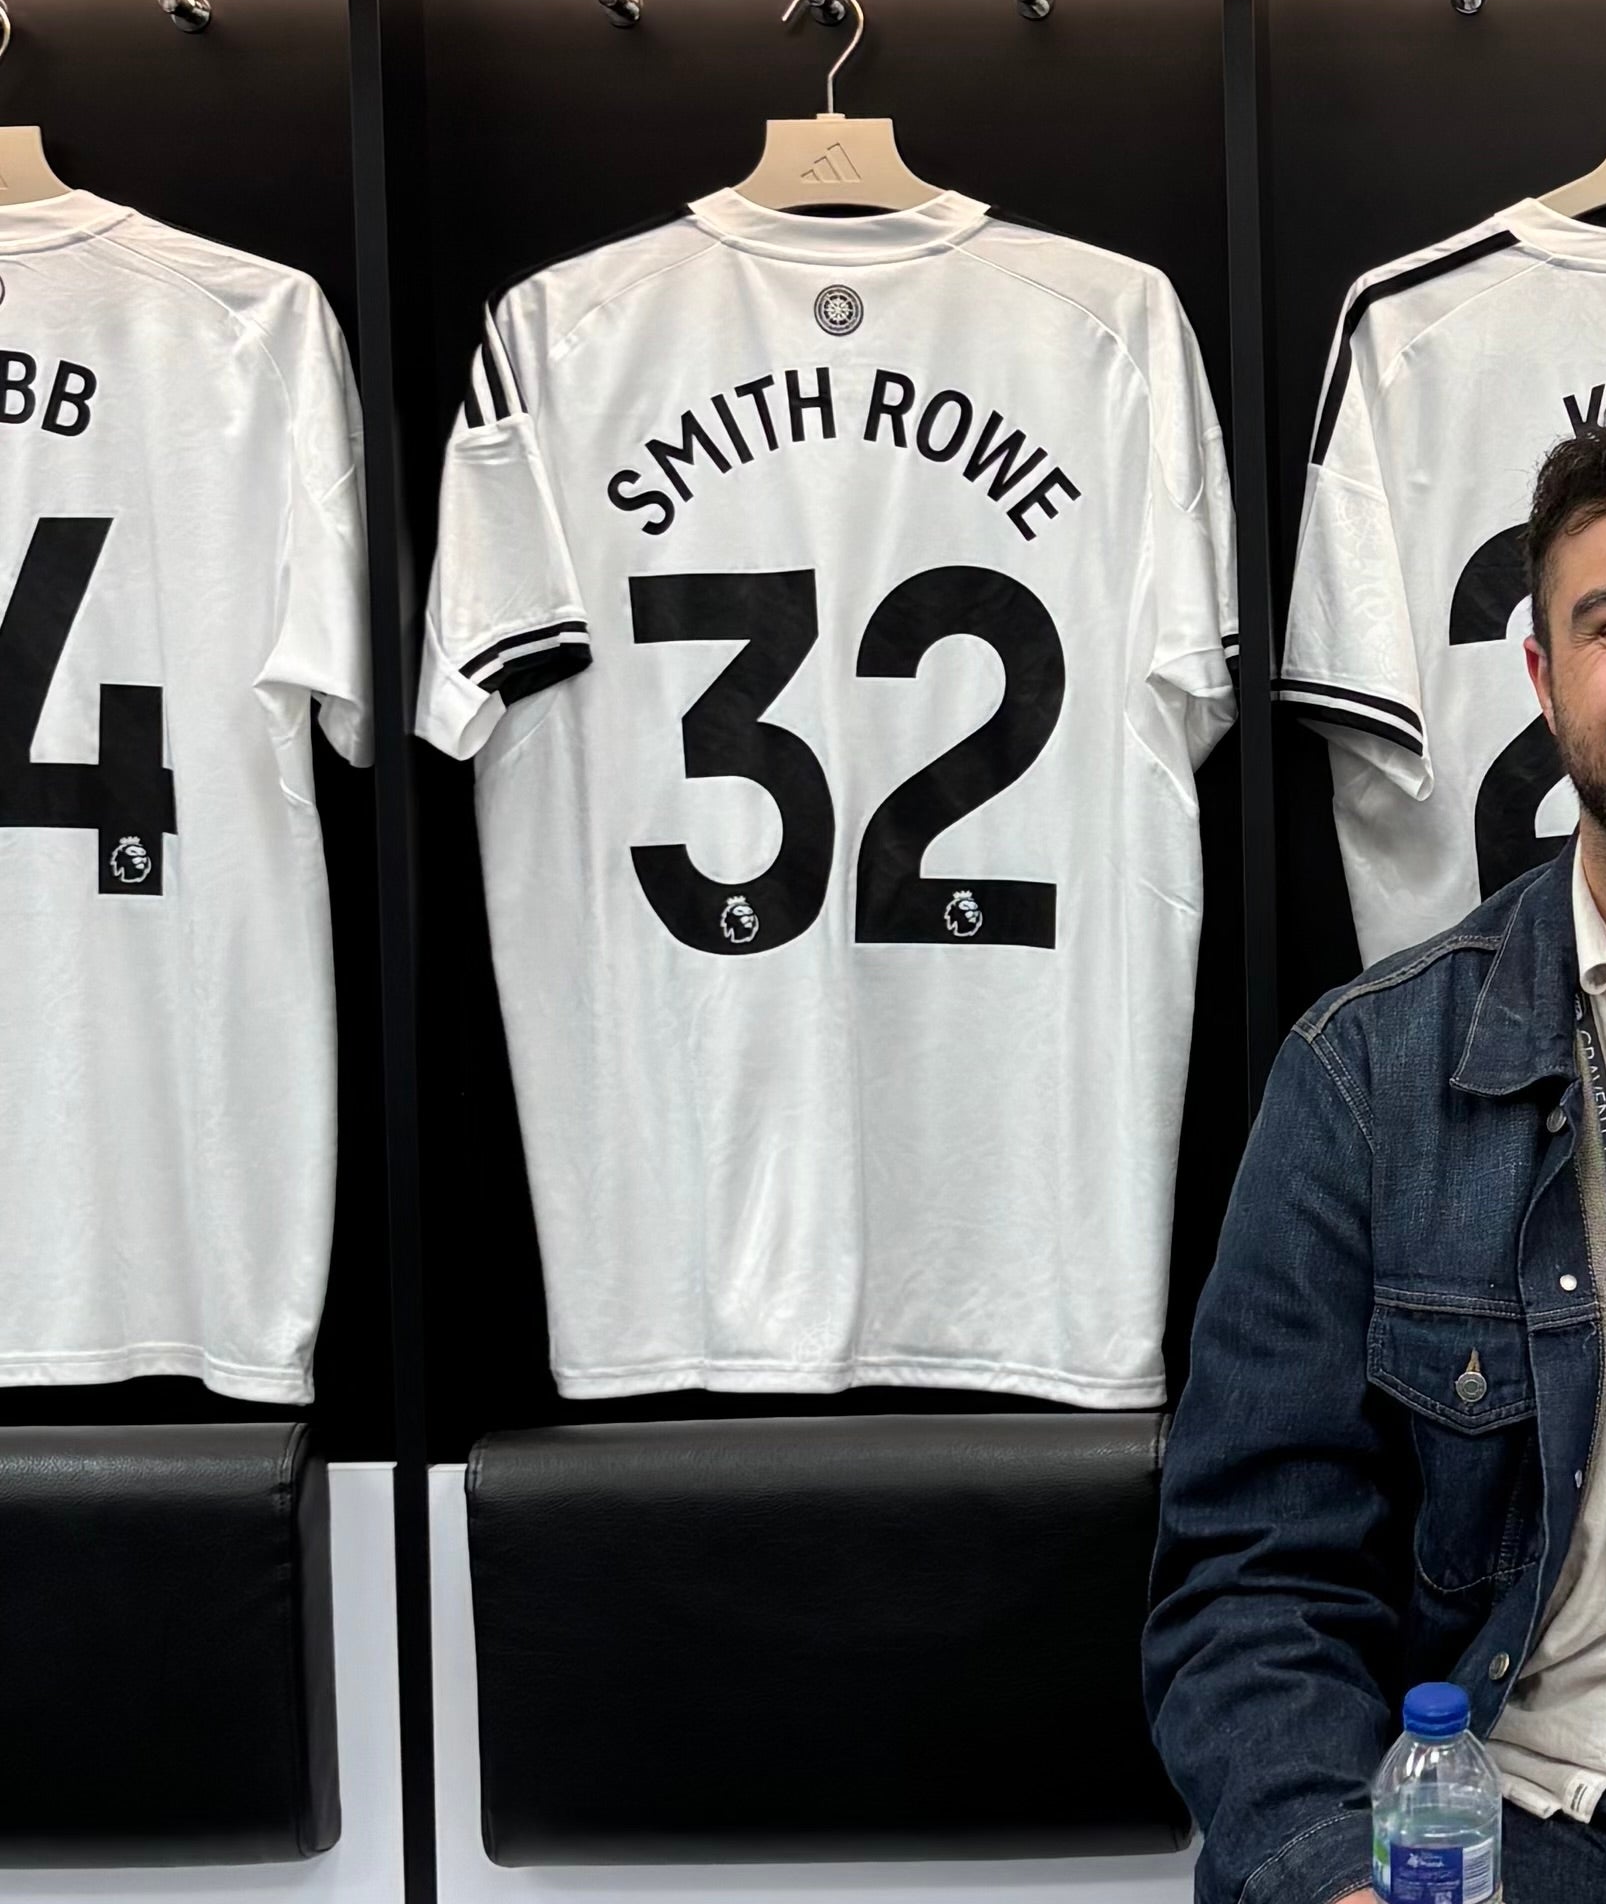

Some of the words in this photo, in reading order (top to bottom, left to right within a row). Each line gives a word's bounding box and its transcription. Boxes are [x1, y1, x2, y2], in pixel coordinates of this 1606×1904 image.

[606, 366, 839, 537] SMITH
[863, 368, 1083, 542] ROWE
[628, 564, 1067, 956] 32
